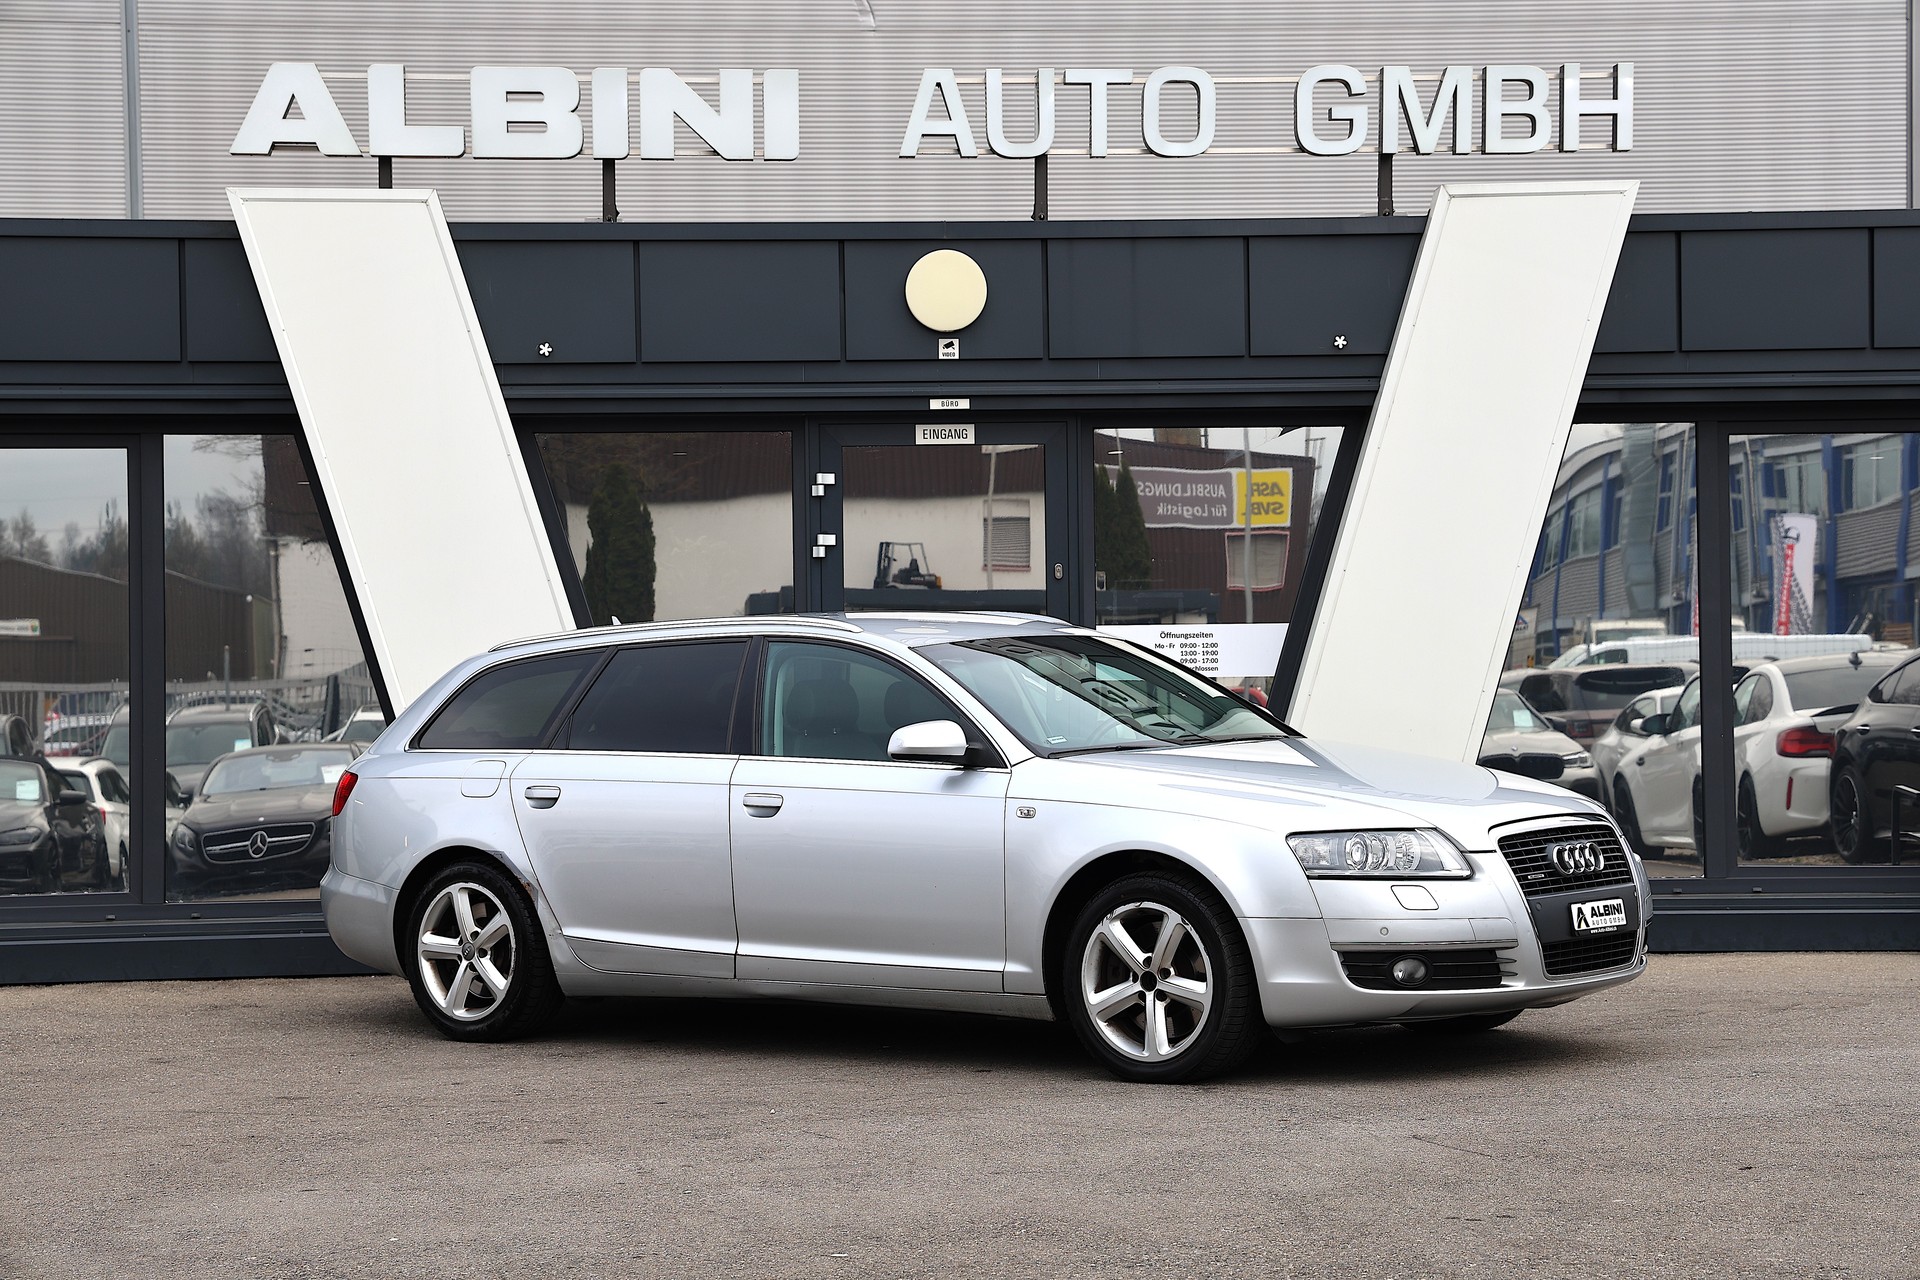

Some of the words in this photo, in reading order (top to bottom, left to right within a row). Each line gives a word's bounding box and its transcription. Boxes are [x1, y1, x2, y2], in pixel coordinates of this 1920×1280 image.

[229, 62, 800, 161] ALBINI
[899, 65, 1216, 158] AUTO
[1295, 62, 1635, 155] GMBH
[923, 428, 968, 440] EINGANG
[1160, 631, 1213, 640] Öffnungszeiten
[1590, 903, 1623, 918] ALBINI
[1591, 917, 1608, 927] AUTO
[1608, 915, 1625, 925] GMBH
